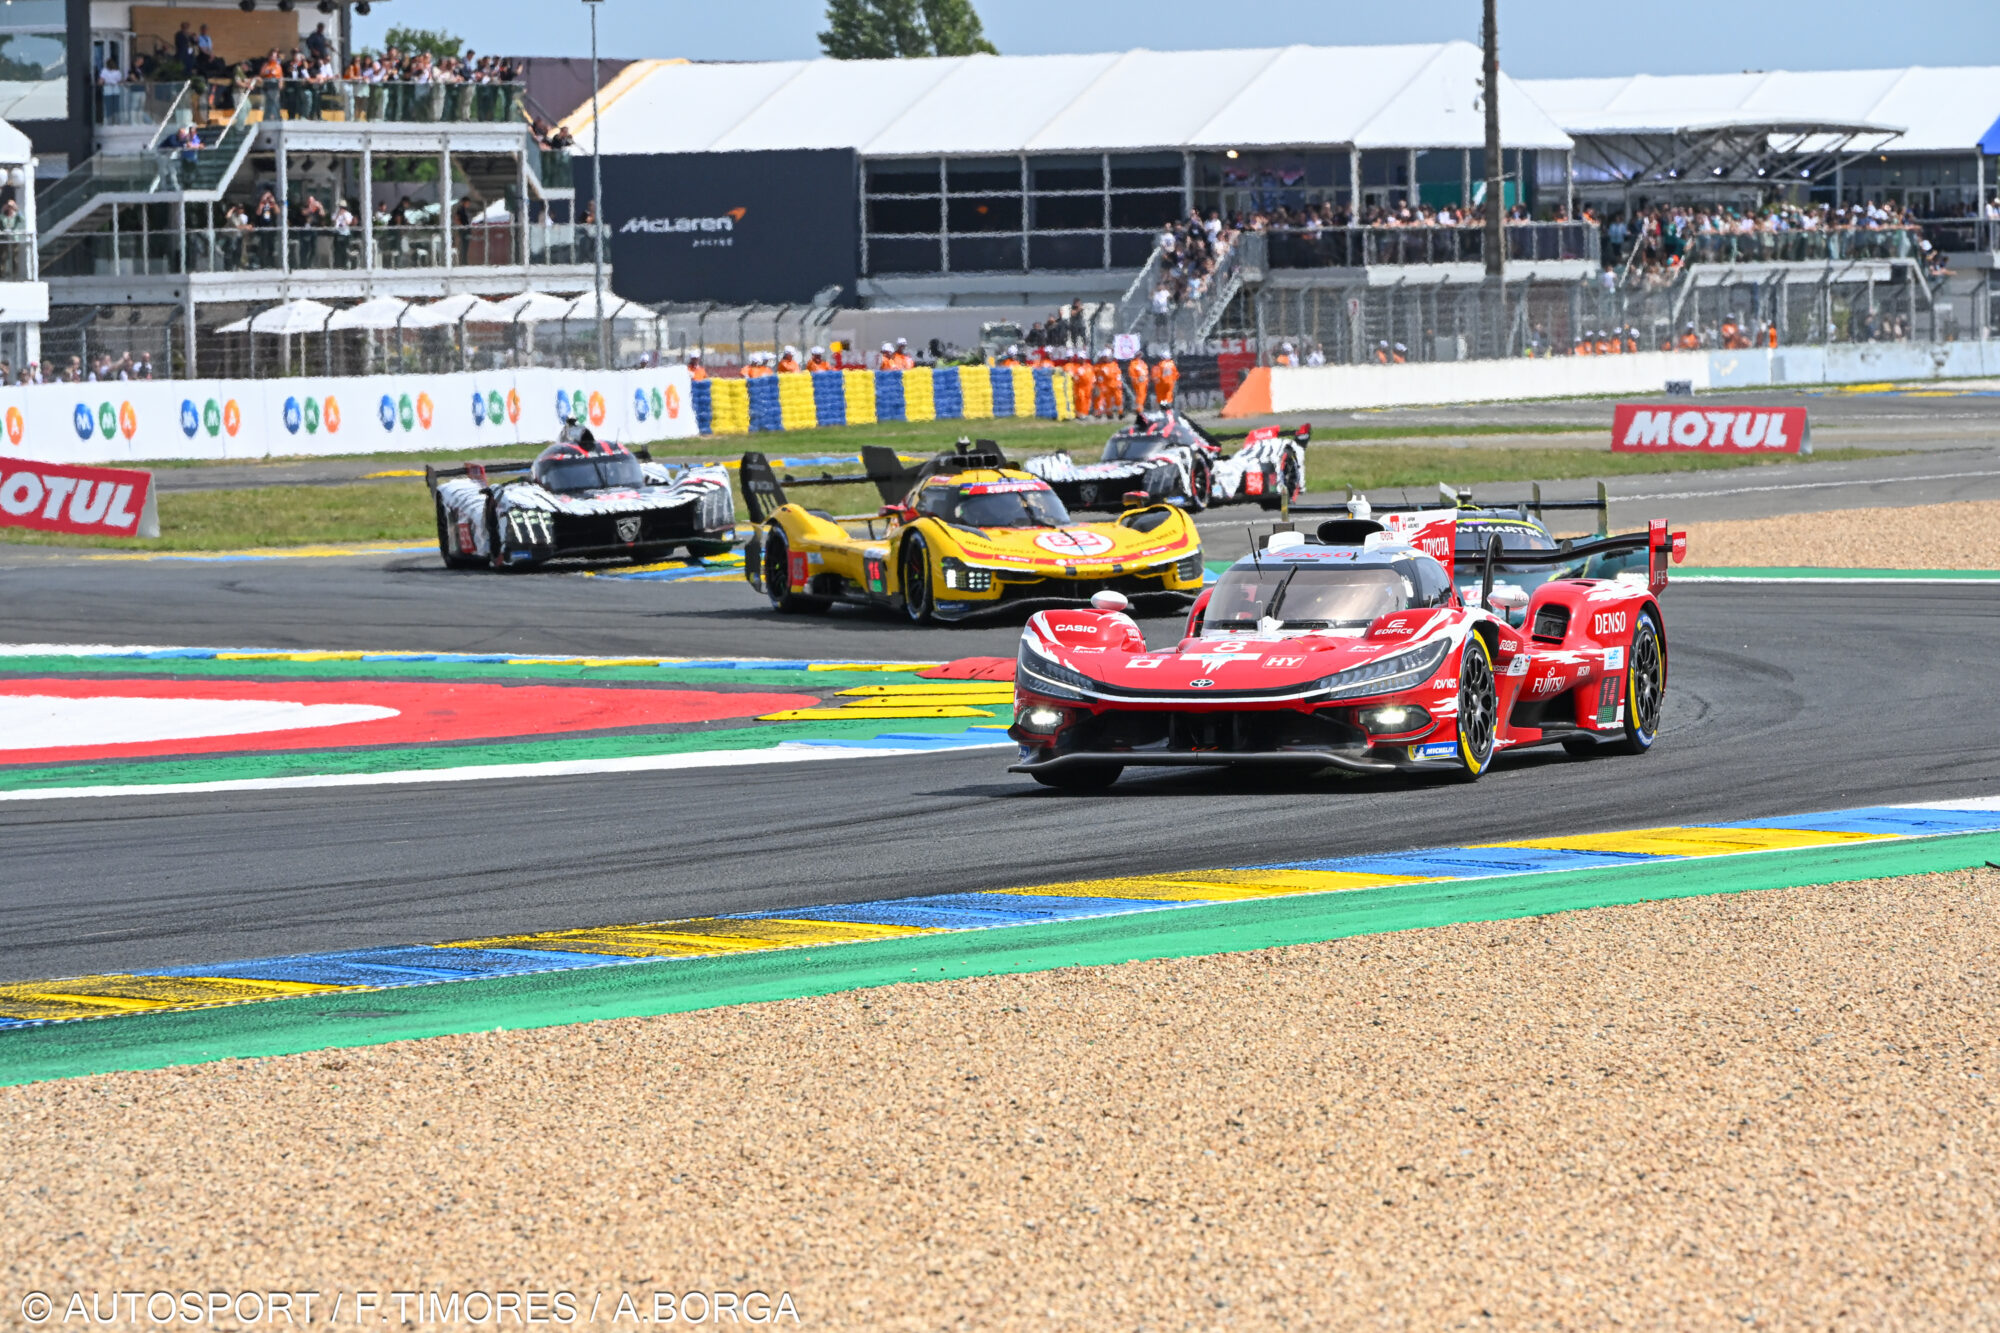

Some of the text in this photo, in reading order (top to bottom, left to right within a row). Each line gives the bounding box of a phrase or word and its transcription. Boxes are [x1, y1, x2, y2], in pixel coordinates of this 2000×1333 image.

[620, 216, 734, 233] McLaren
[1623, 411, 1788, 448] MOTUL
[0, 471, 136, 528] OTUL
[1478, 525, 1542, 538] MARTIN
[1422, 537, 1450, 556] TOYOTA
[1266, 551, 1353, 559] DENSO
[1055, 624, 1098, 634] CASIO
[1595, 611, 1626, 635] DENSO
[1374, 627, 1414, 636] EDIFICE
[1213, 641, 1248, 653] 8
[1268, 657, 1303, 668] HY
[1532, 676, 1566, 696] FUJITSU
[1426, 746, 1455, 755] MICHELIN
